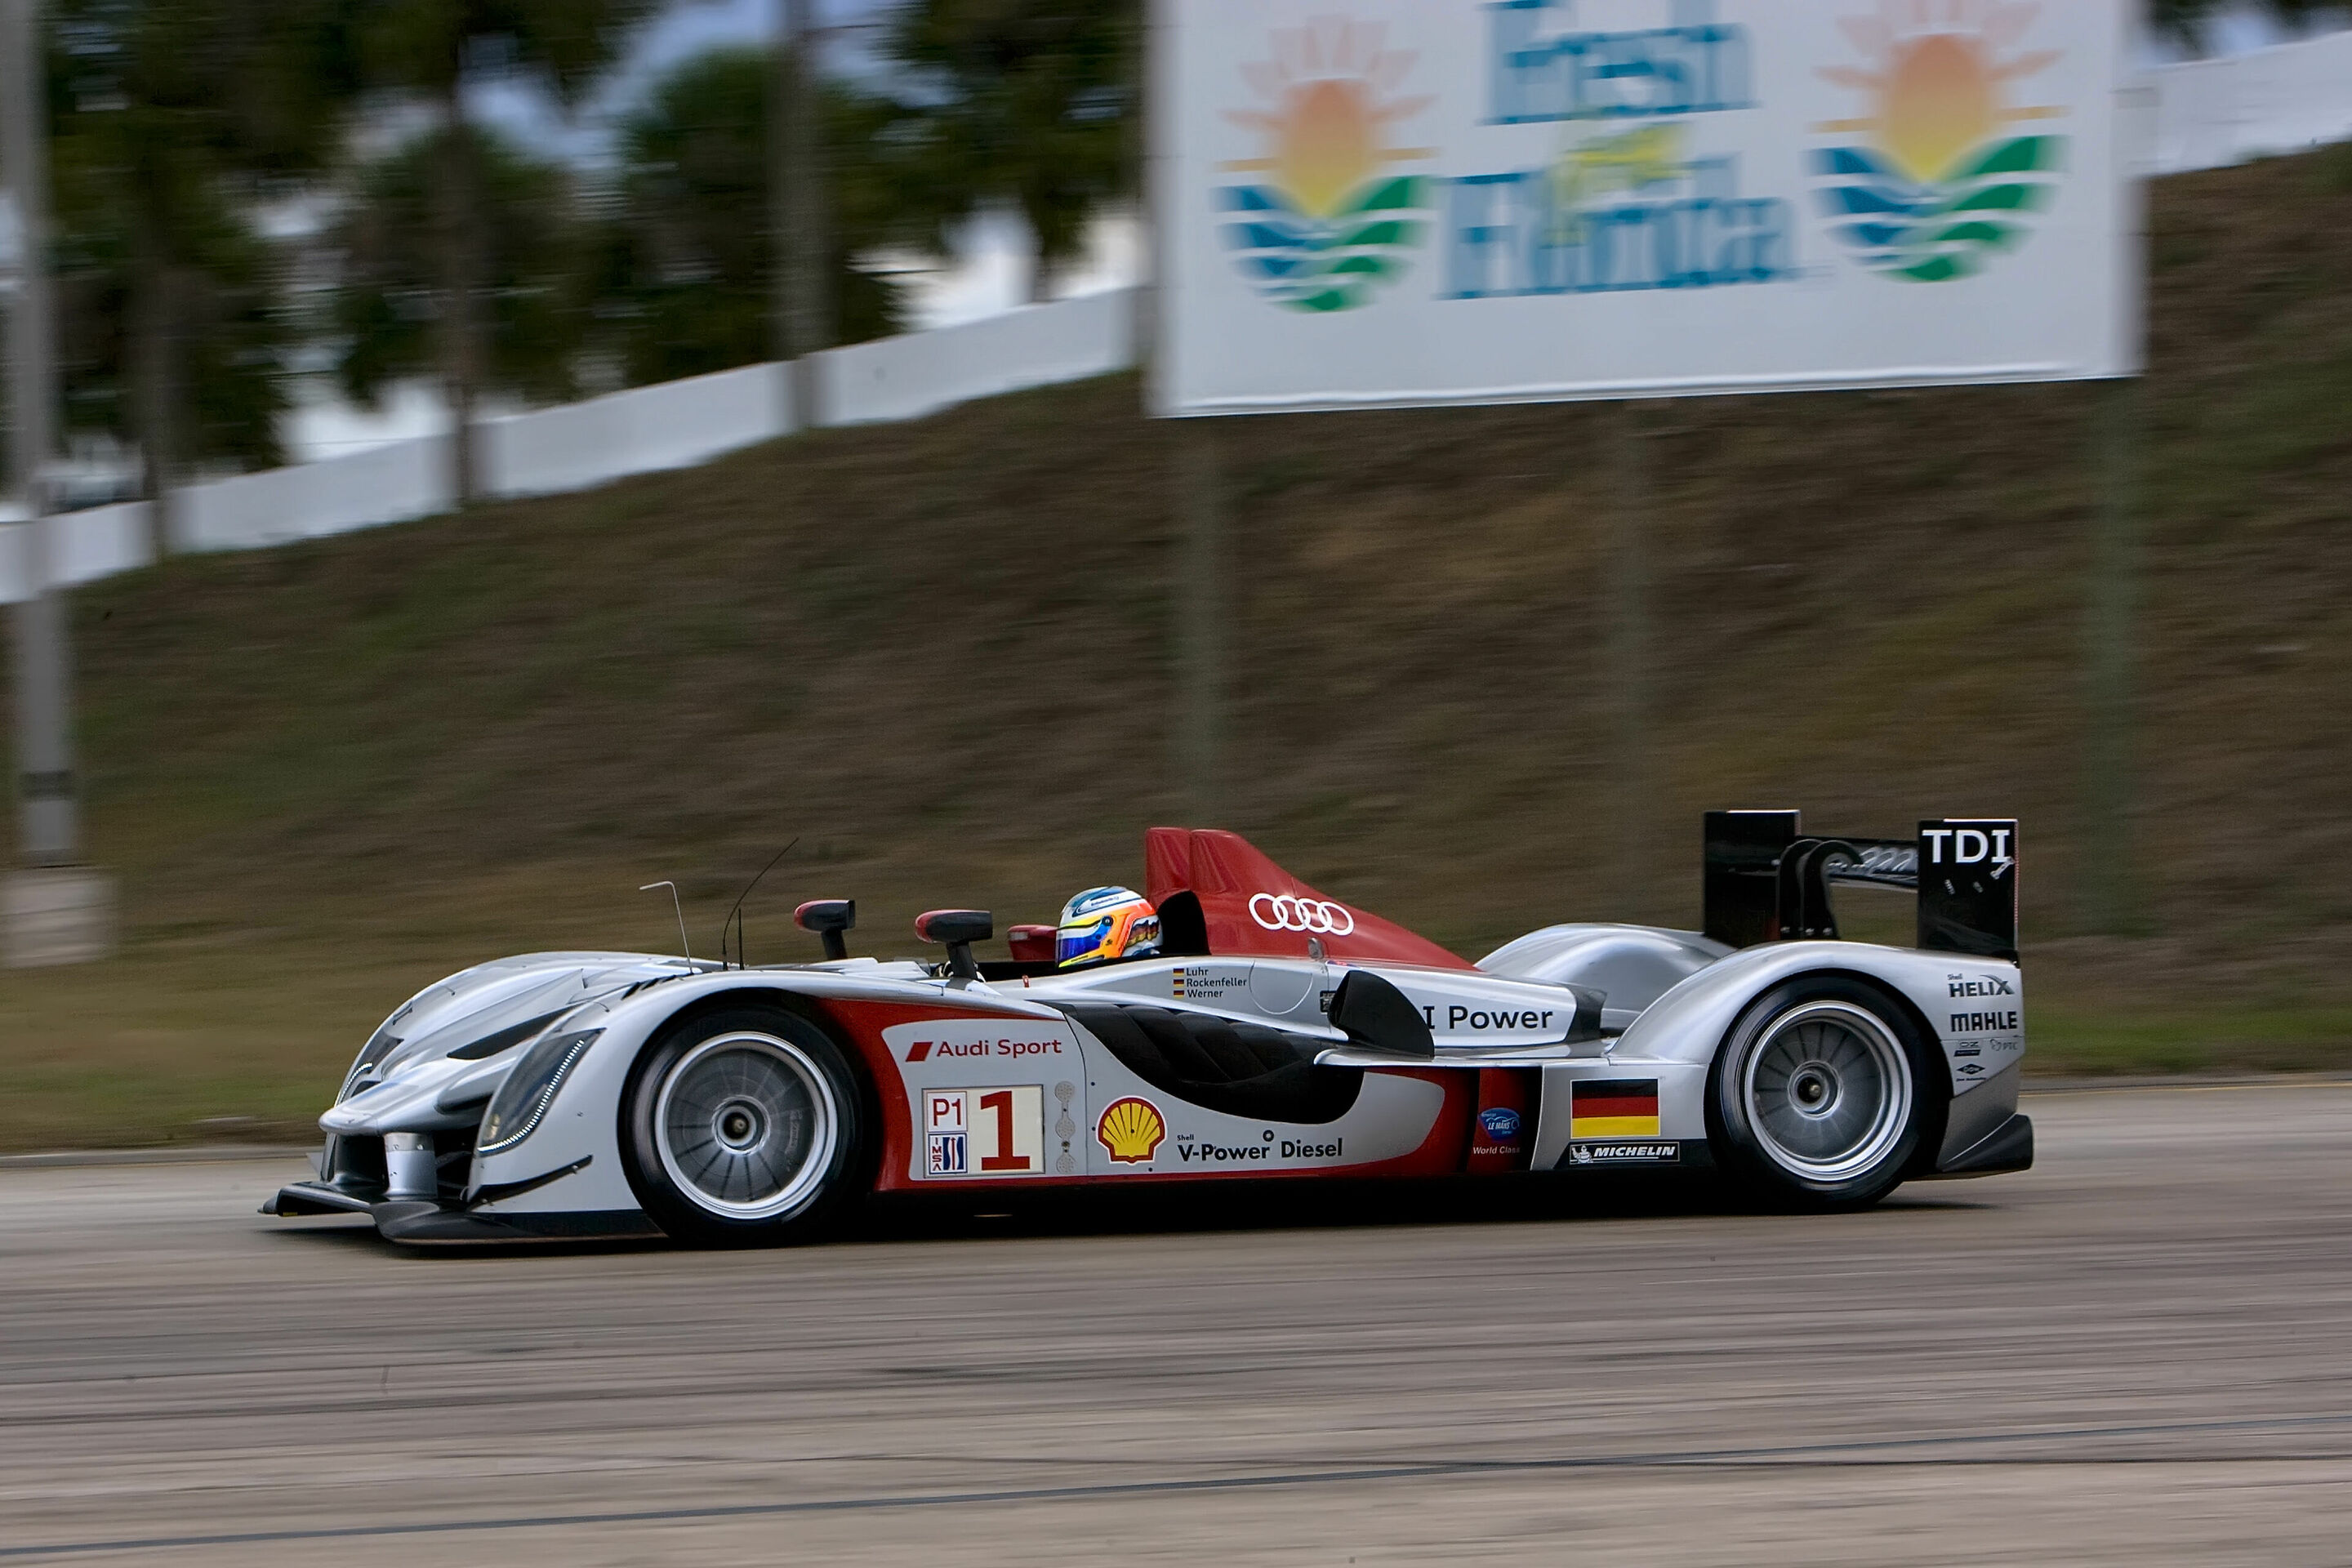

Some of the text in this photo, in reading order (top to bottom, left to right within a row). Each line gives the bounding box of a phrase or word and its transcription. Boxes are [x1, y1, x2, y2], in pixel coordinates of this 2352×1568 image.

[1922, 829, 2010, 863] TDI
[1186, 967, 1209, 976] Luhr
[1186, 977, 1247, 987] Rockenfeller
[1187, 989, 1223, 998] Werner
[1949, 975, 2015, 997] HELIX
[1449, 1005, 1553, 1029] Power
[1950, 1011, 2018, 1032] MAHLE
[937, 1039, 1062, 1058] Audi Sport
[933, 1098, 961, 1126] P1
[980, 1090, 1030, 1170] 1
[932, 1137, 942, 1171] IMSA
[1178, 1138, 1343, 1162] V-Power Diesel
[1472, 1147, 1498, 1155] World
[1593, 1146, 1675, 1157] MICHELIN
